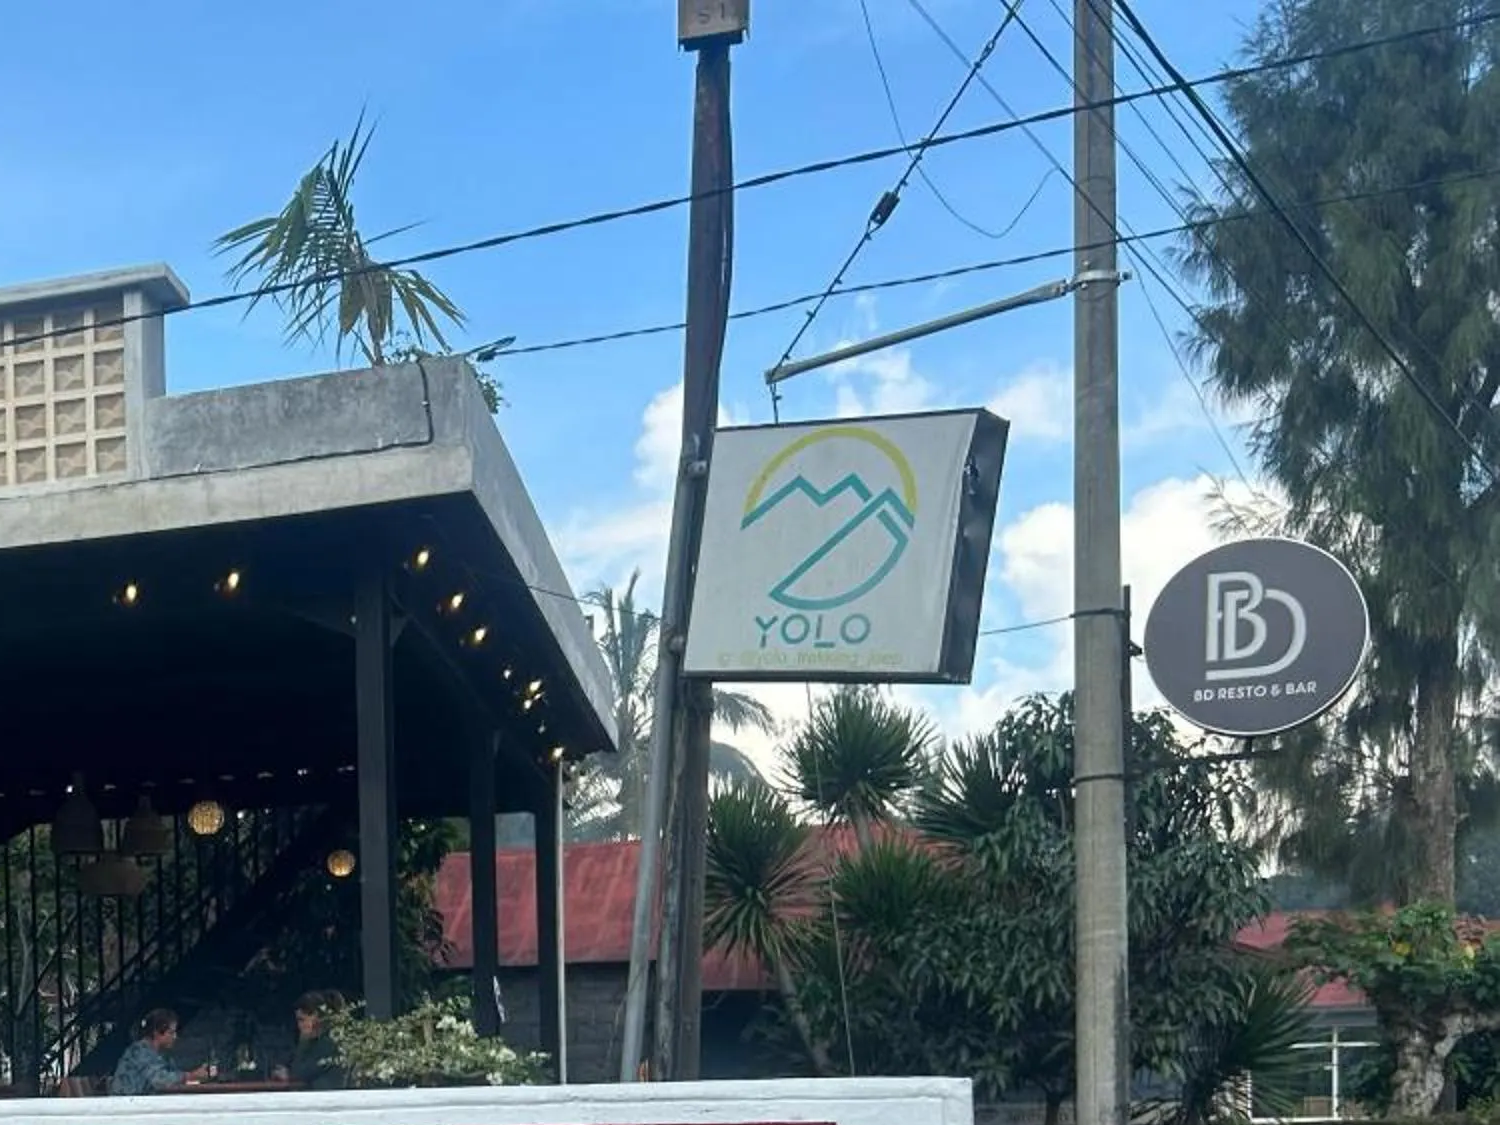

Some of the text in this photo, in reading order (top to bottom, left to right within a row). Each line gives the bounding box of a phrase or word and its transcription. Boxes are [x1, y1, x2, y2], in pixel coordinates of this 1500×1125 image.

[755, 613, 871, 648] YOLO
[1194, 680, 1317, 702] BD RESTO & BAR
